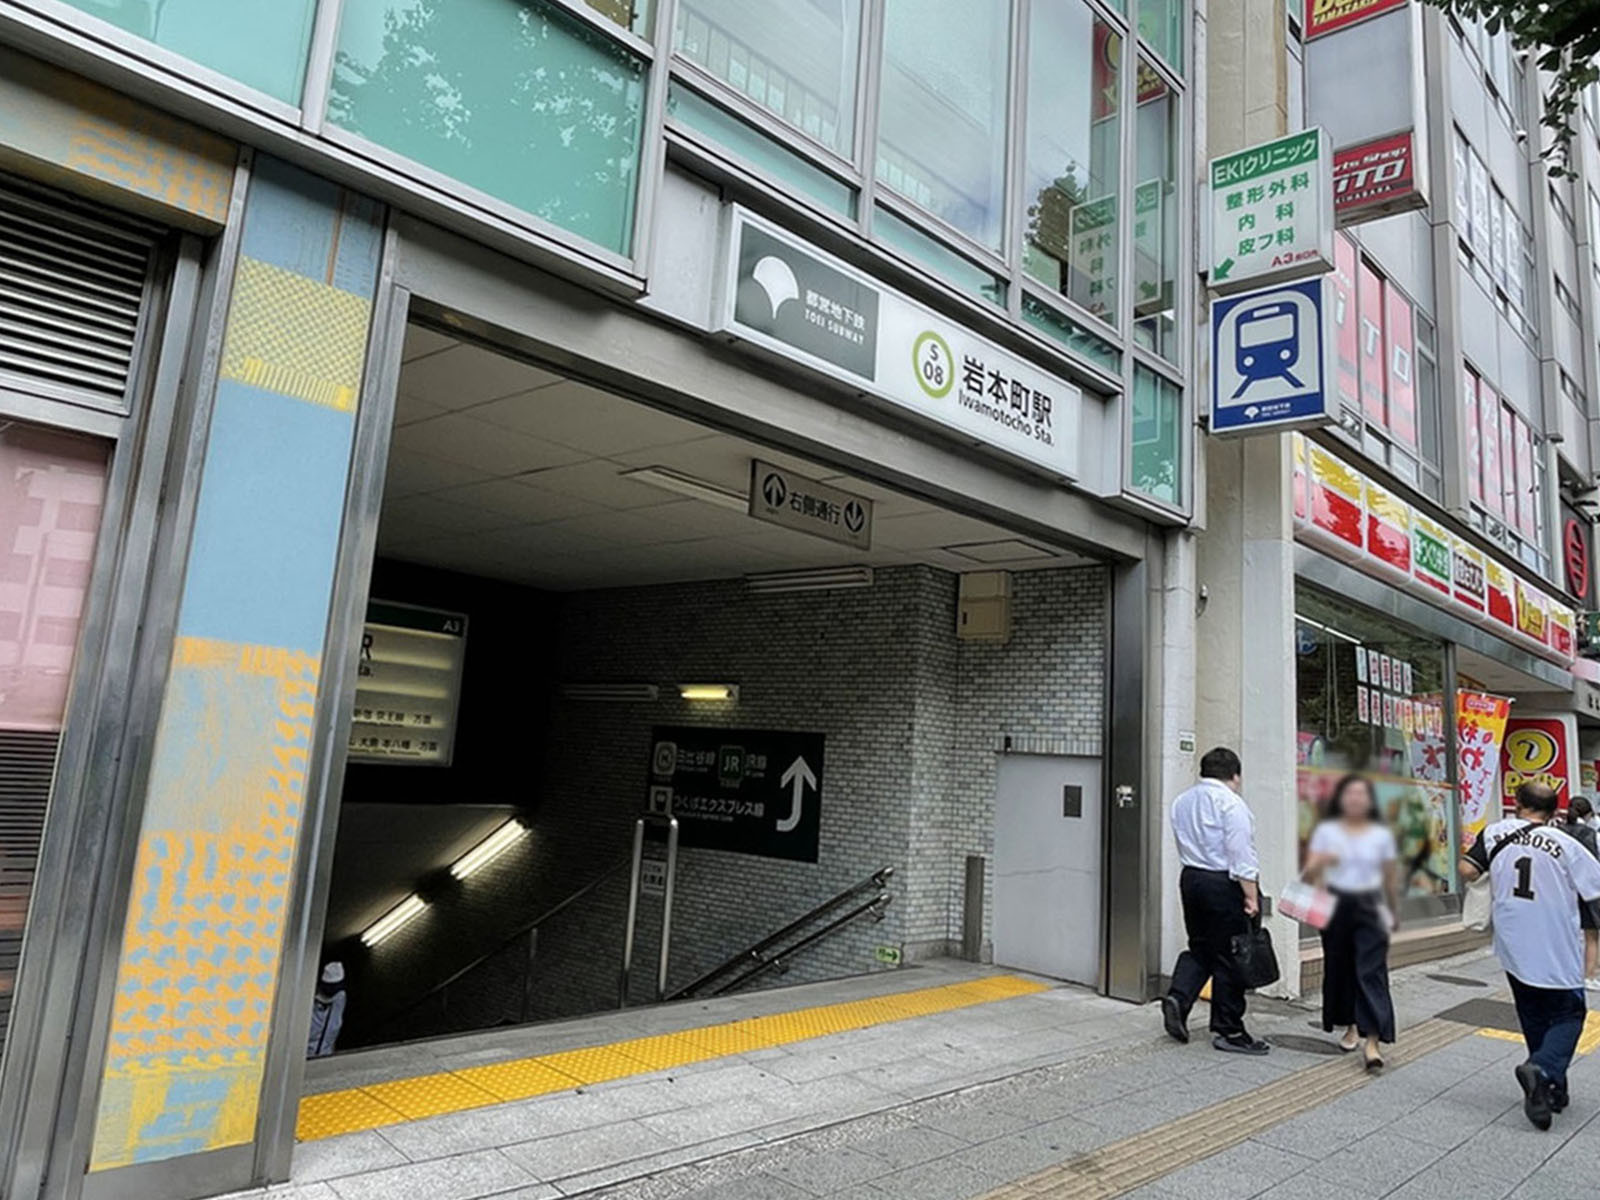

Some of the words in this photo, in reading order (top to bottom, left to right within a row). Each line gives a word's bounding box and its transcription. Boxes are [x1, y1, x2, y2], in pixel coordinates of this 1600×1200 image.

[1213, 138, 1317, 185] EKIクリニック
[1226, 171, 1310, 212] 整形外科
[1335, 185, 1392, 204] KIHABARA
[1237, 226, 1295, 257] 皮フ科
[805, 289, 866, 332] 都営地下鉄
[827, 319, 865, 346] SUBWAY
[929, 343, 940, 362] S
[923, 360, 944, 387] 08
[962, 354, 1053, 429] 岩本町駅
[958, 388, 1032, 437] Iwamotocho
[1034, 424, 1055, 448] Sta.
[442, 619, 460, 633] A3
[722, 754, 741, 773] JR
[1512, 856, 1535, 901] 1
